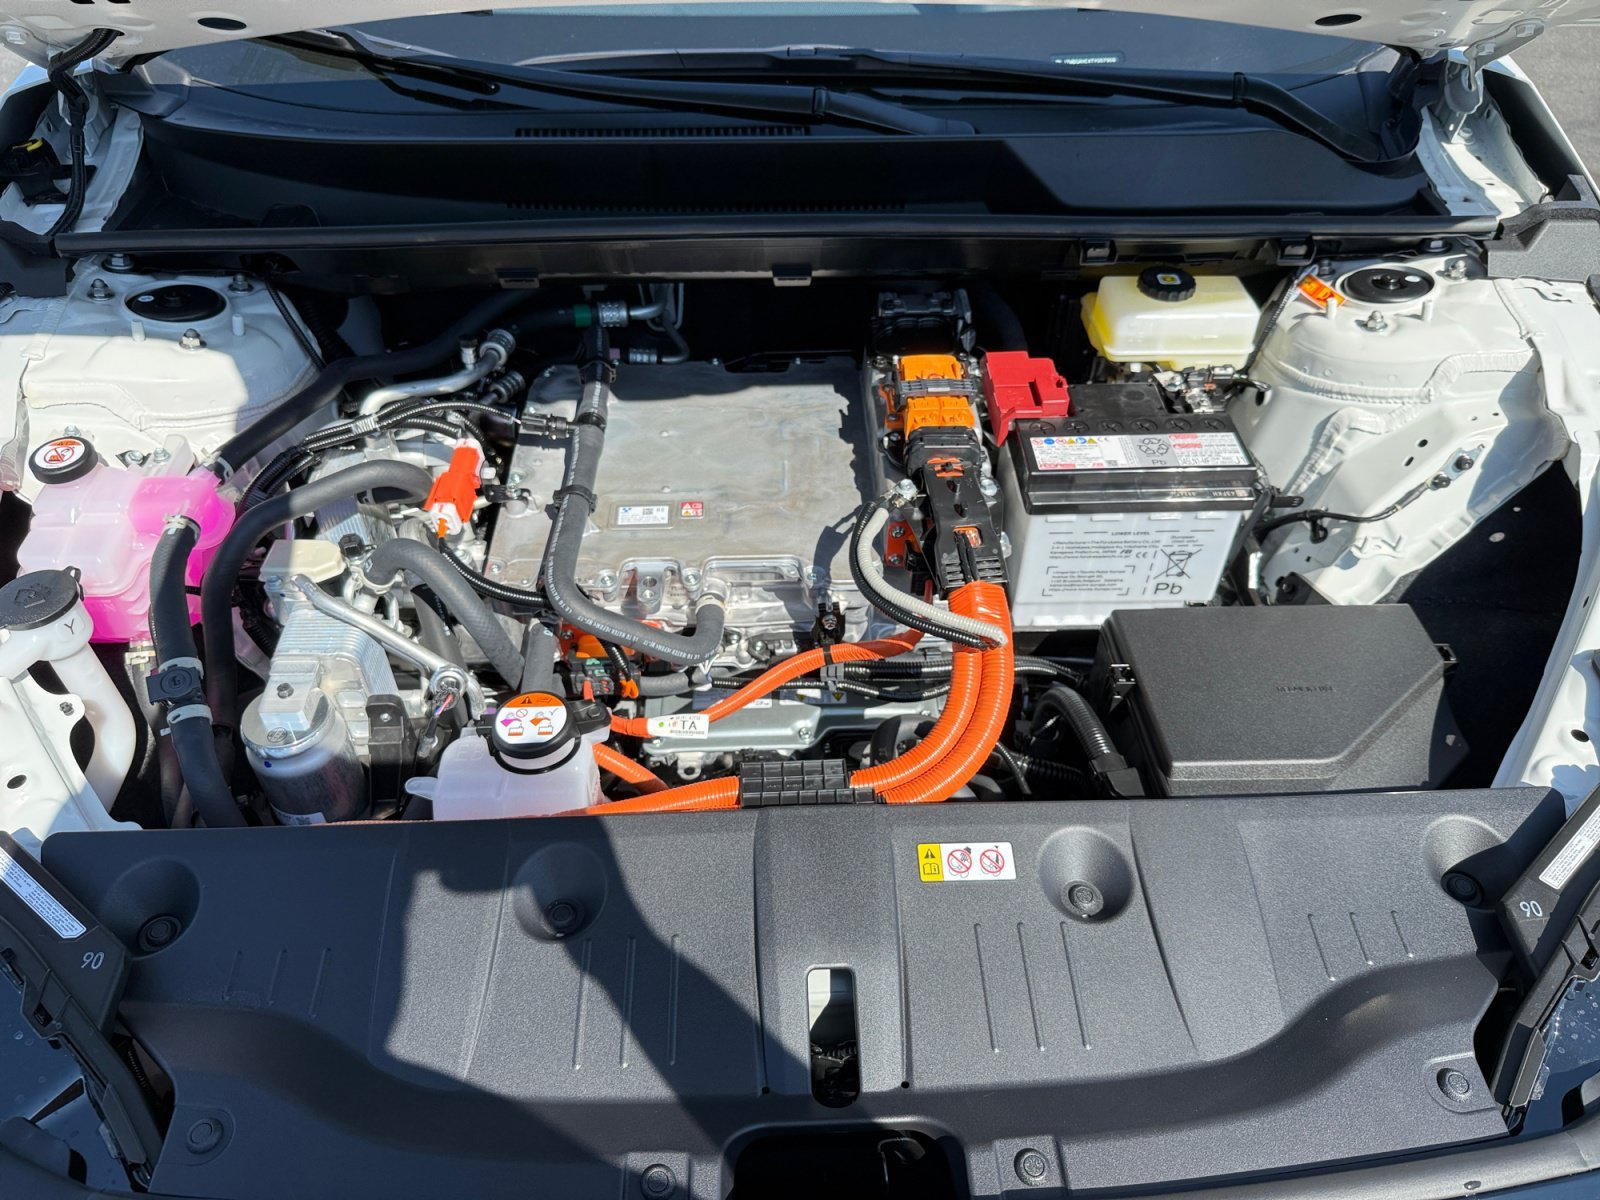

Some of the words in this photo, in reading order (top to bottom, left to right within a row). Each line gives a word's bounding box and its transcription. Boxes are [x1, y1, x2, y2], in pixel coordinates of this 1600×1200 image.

[1153, 582, 1183, 595] Pb
[64, 618, 75, 635] Y
[680, 720, 697, 730] TA
[1519, 900, 1543, 918] 90
[80, 951, 105, 969] 90
